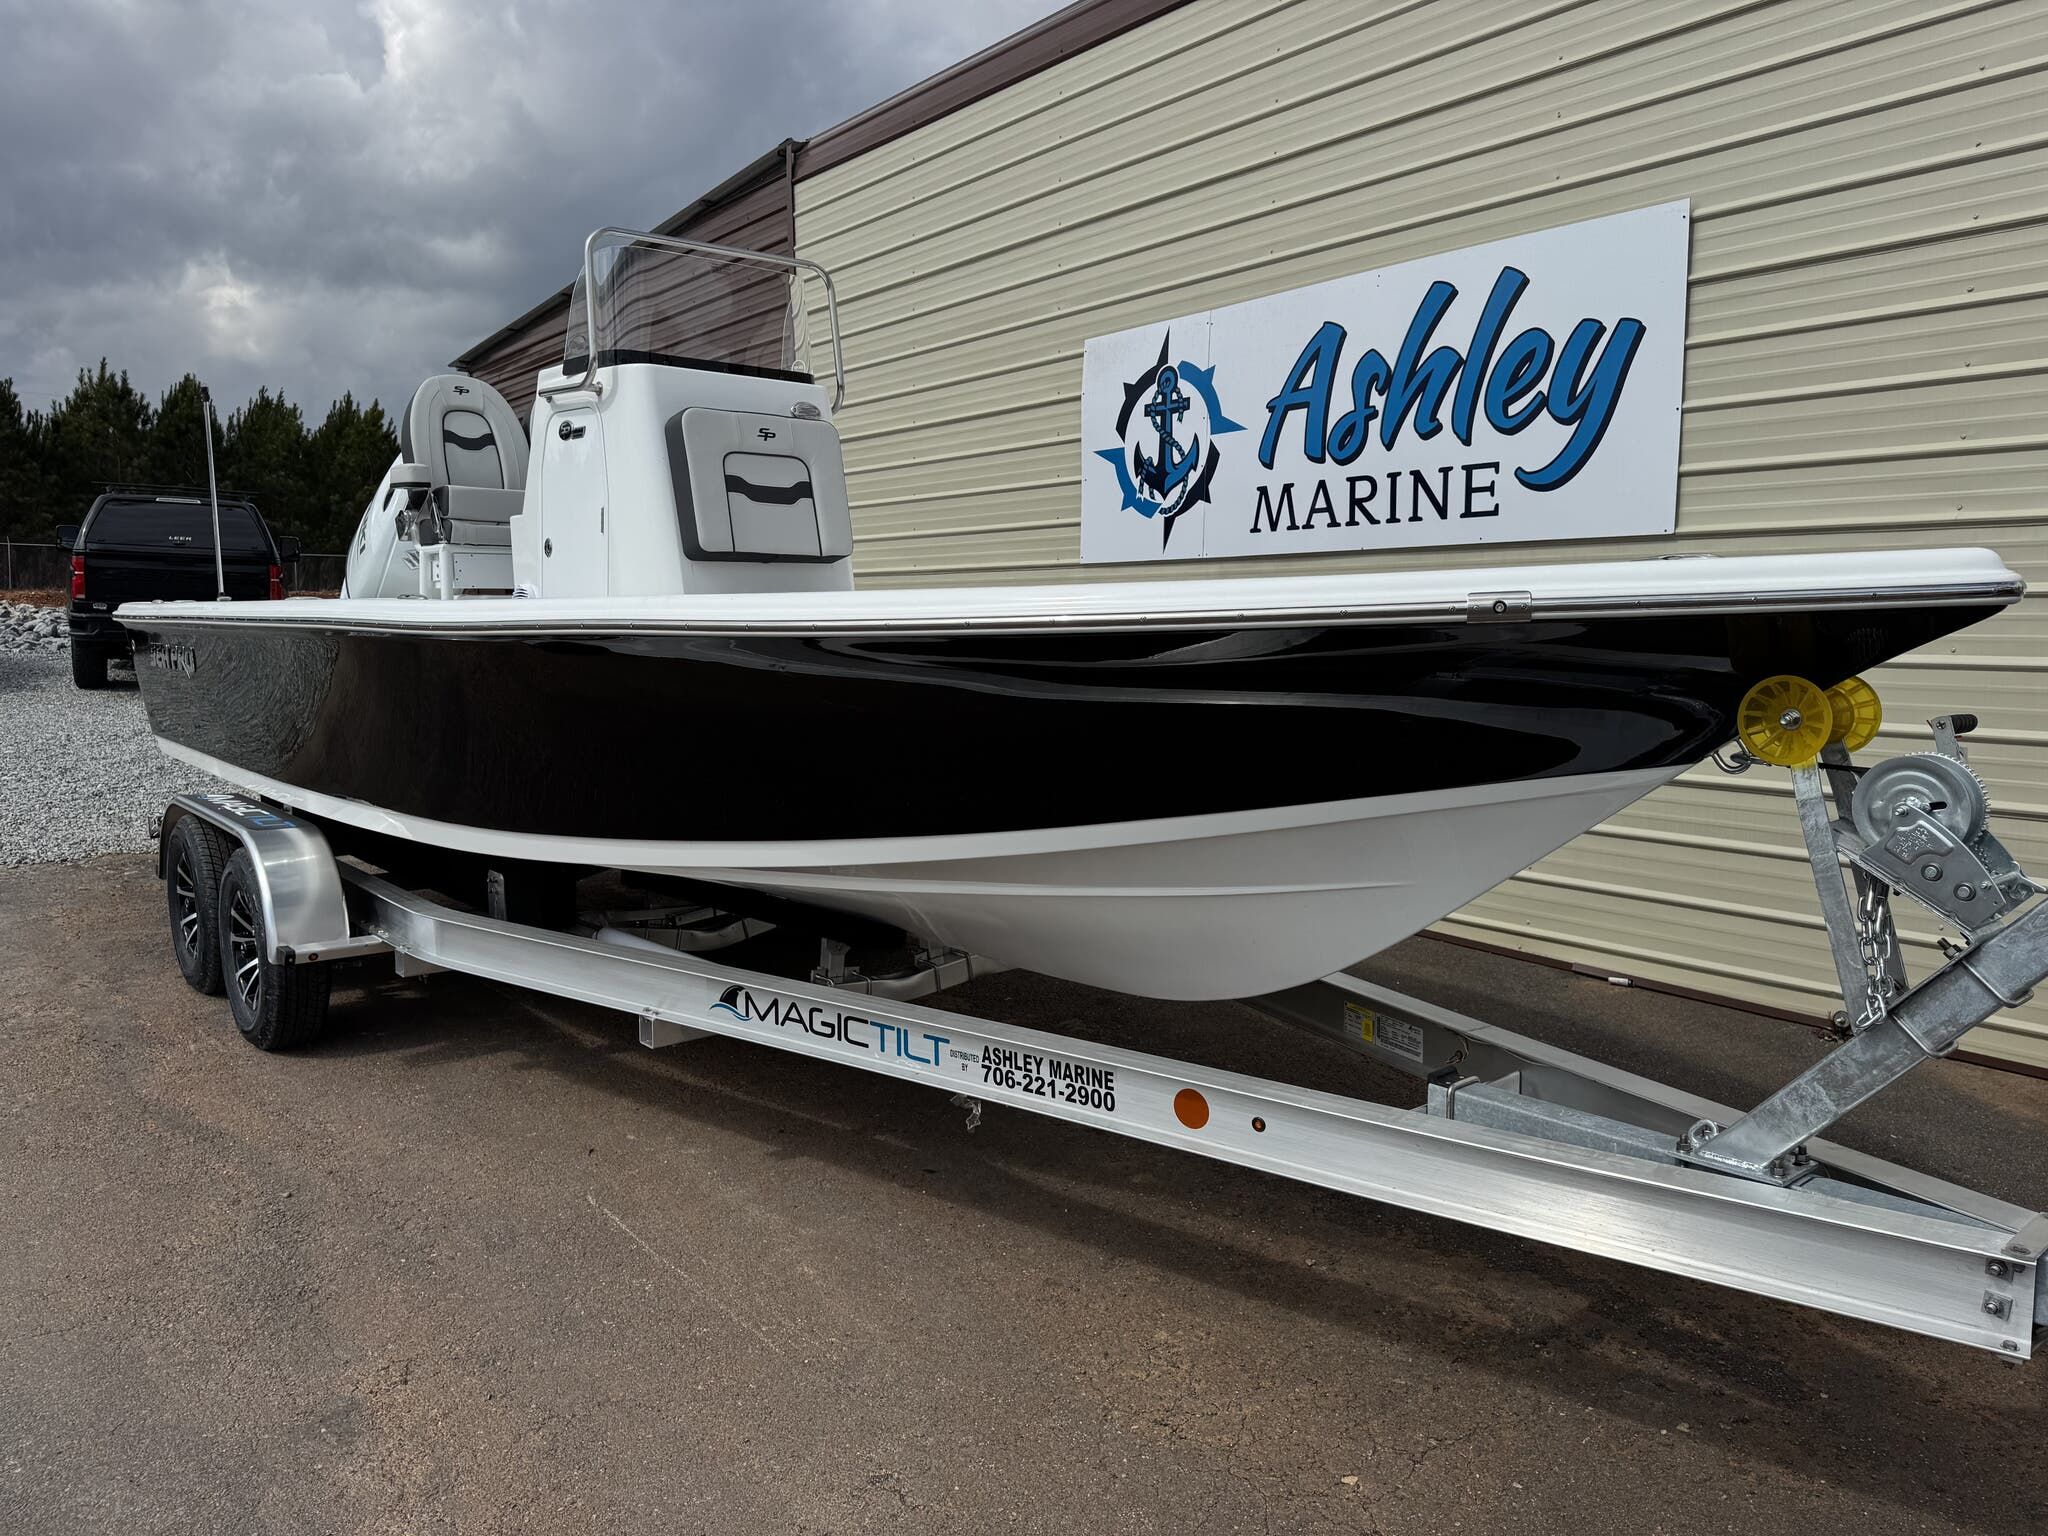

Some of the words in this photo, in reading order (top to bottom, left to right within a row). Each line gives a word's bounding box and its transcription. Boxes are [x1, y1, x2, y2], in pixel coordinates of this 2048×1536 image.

[1258, 265, 1647, 492] Ashley
[1249, 461, 1501, 535] MARINE
[744, 990, 950, 1067] MAGICTILT
[949, 1049, 980, 1064] DISTRIBUTED
[961, 1062, 969, 1072] BY
[981, 1045, 1044, 1075] ASHLEY
[1049, 1059, 1115, 1092] MARINE
[981, 1063, 1116, 1112] 706-221-2900
